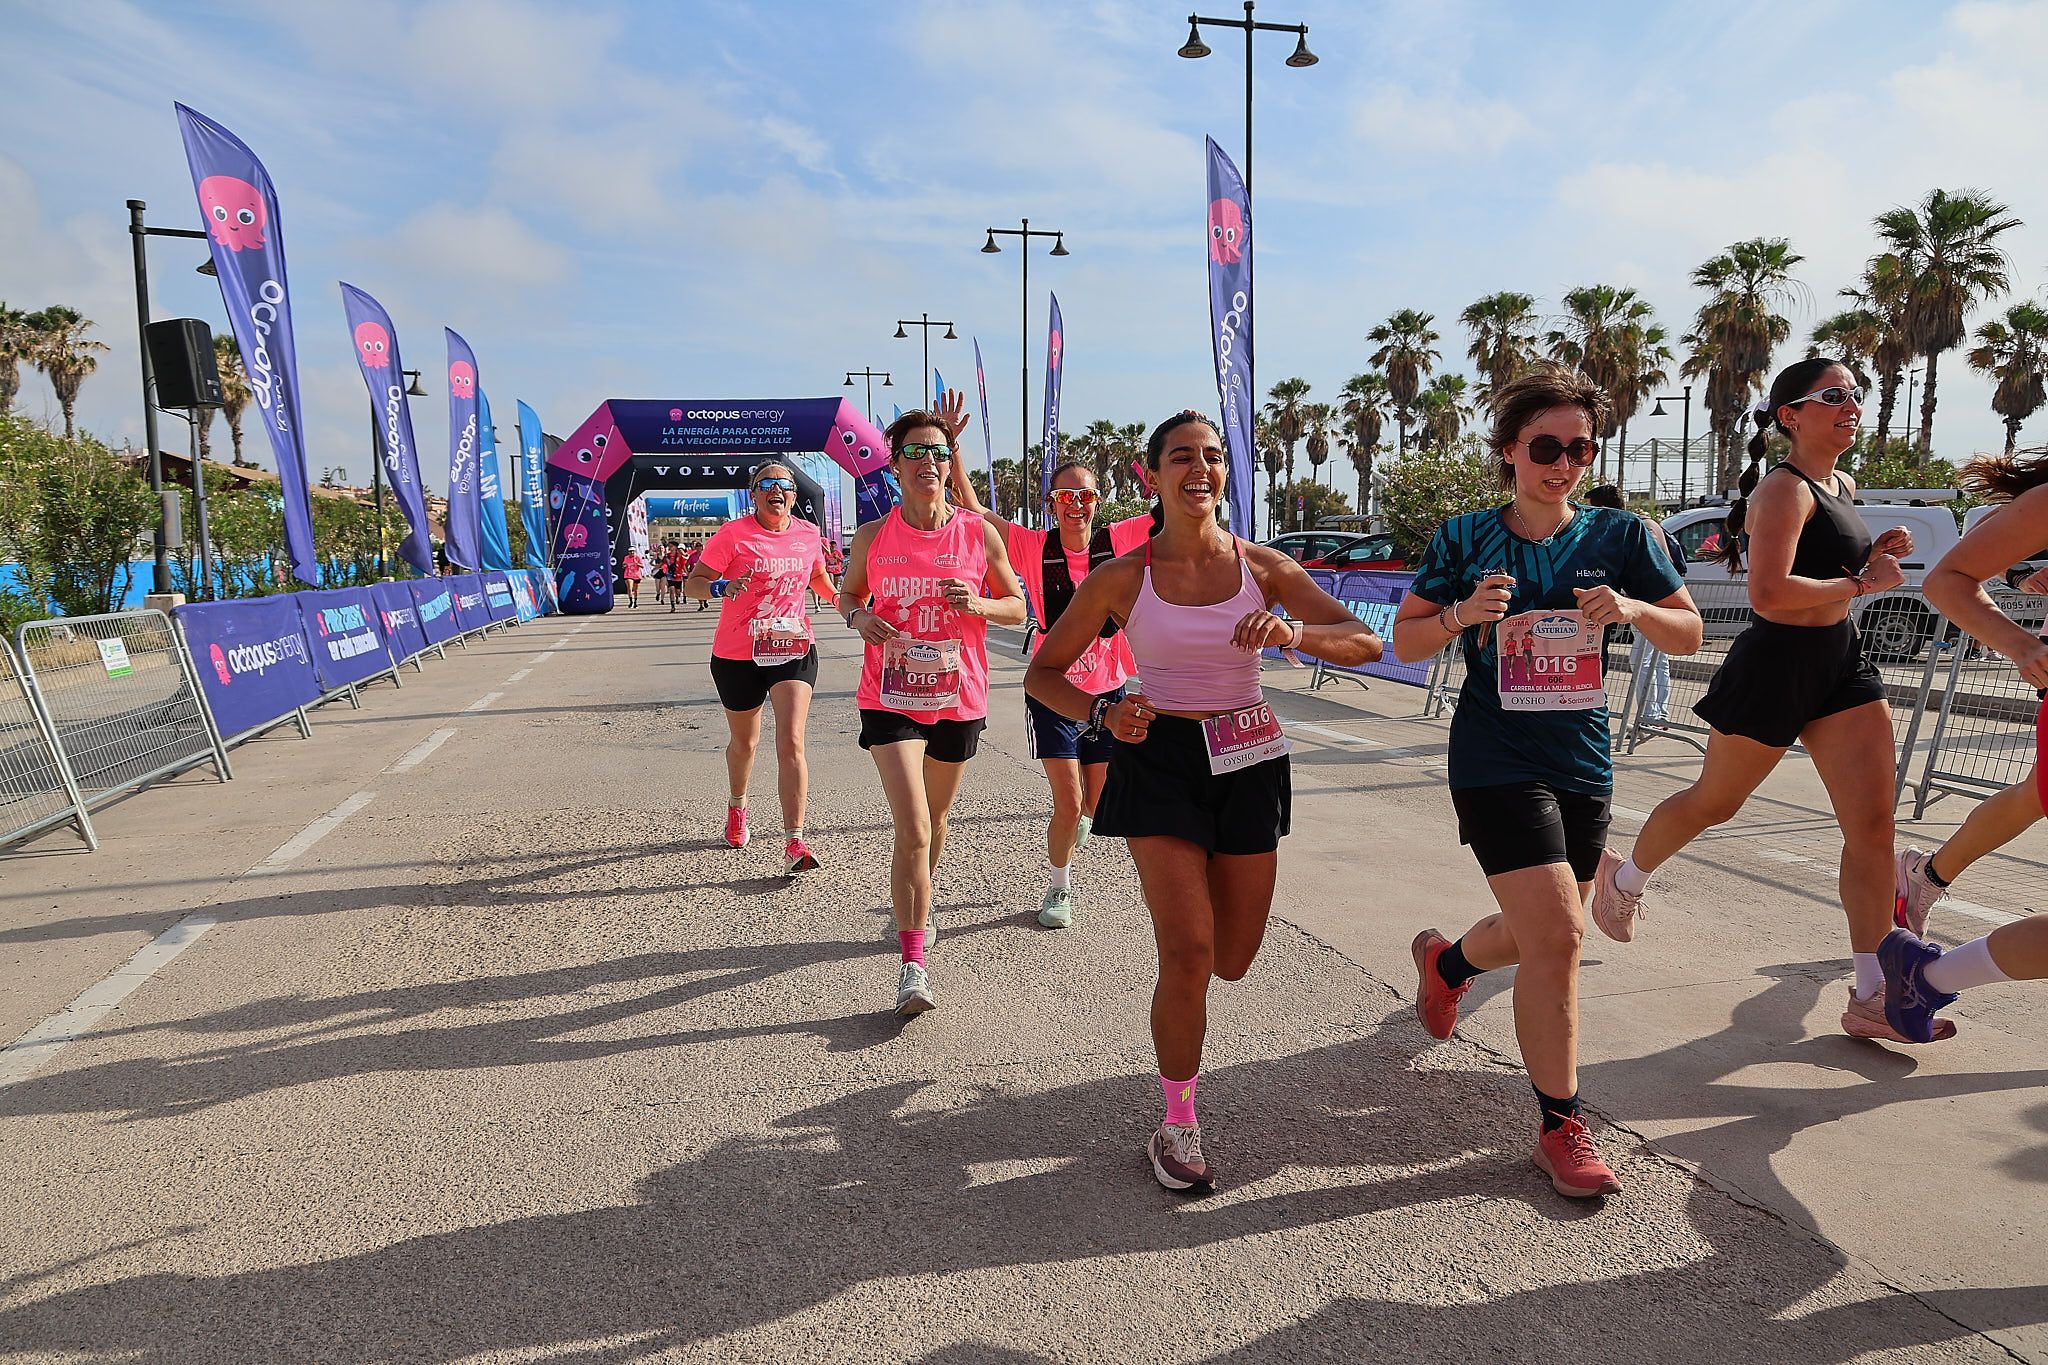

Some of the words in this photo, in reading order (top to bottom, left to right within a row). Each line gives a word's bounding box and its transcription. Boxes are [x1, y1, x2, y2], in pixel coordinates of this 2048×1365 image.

[687, 408, 740, 422] octopus
[741, 410, 785, 423] energy
[662, 427, 676, 435] LA
[677, 425, 719, 435] ENERGÍA
[722, 427, 749, 436] PARA
[750, 427, 790, 435] CORRER
[661, 437, 669, 445] A
[671, 437, 684, 445] LA
[686, 437, 742, 445] VELOCIDAD
[877, 555, 908, 566] OYSHO
[882, 577, 942, 597] CARRER
[2000, 601, 2024, 610] 8095
[918, 605, 940, 633] DE
[1507, 620, 1530, 628] SUMA
[772, 639, 794, 648] 016
[228, 640, 277, 676] octopus
[272, 632, 309, 665] energy
[1534, 656, 1578, 673] 016
[907, 672, 938, 685] 016
[1547, 675, 1564, 683] 606
[889, 697, 914, 706] OYSHO
[1511, 696, 1546, 705] OYSHO
[1567, 696, 1594, 705] Santander
[1238, 706, 1270, 730] 016
[1219, 743, 1244, 754] CARRERA
[1223, 752, 1255, 767] OYSHO
